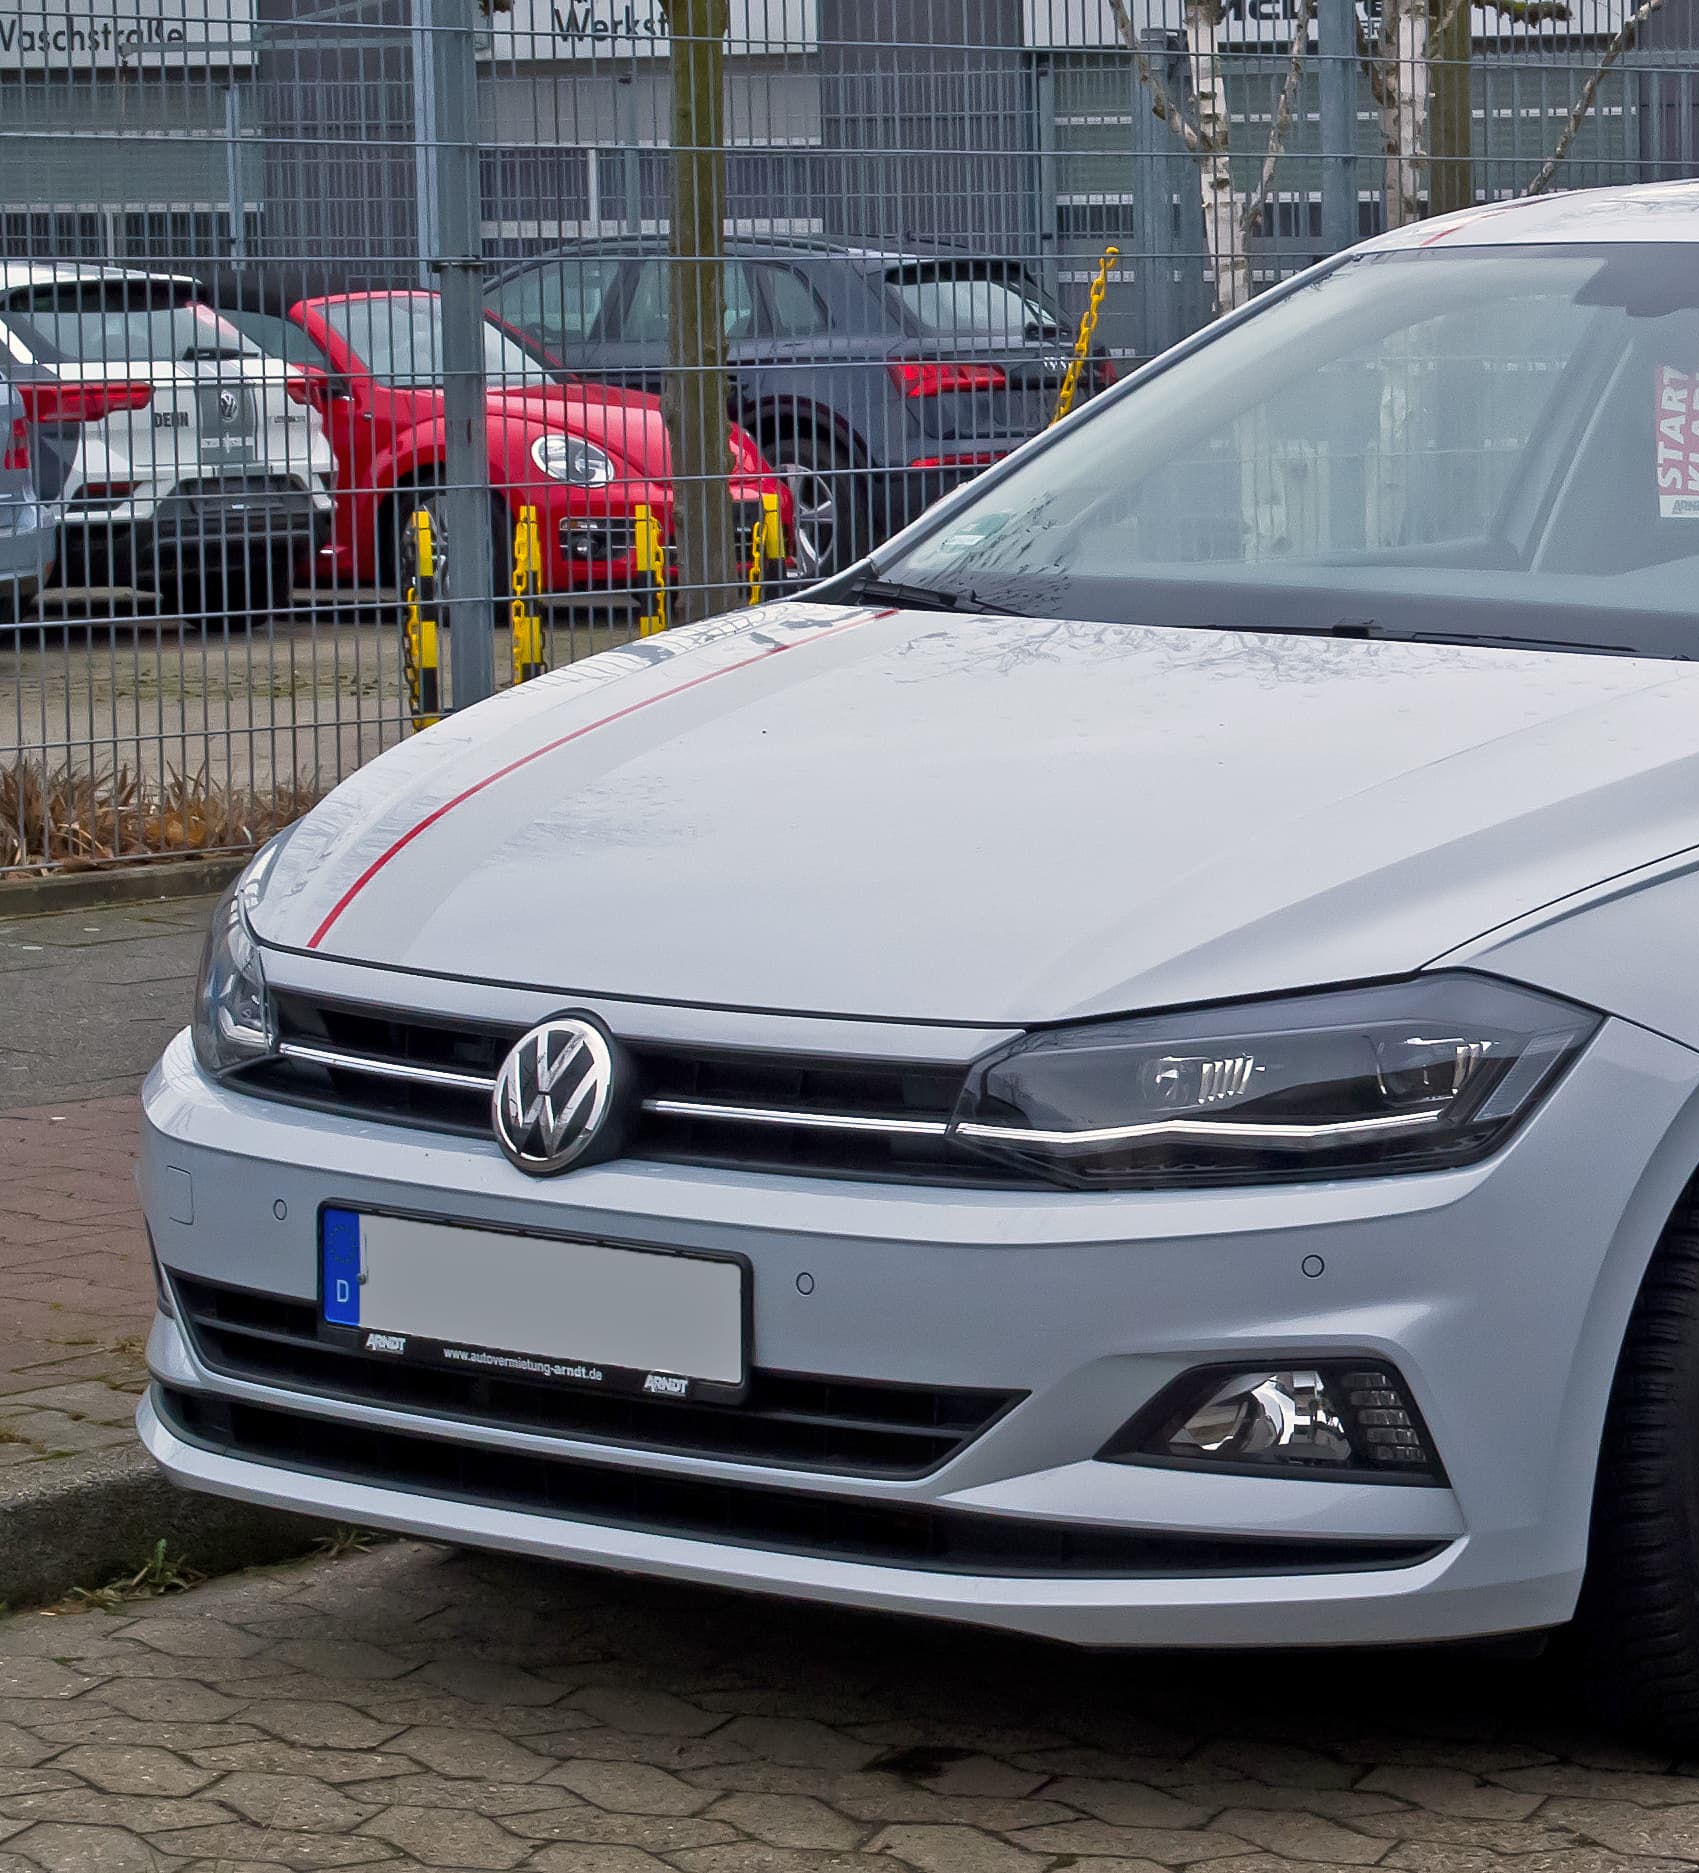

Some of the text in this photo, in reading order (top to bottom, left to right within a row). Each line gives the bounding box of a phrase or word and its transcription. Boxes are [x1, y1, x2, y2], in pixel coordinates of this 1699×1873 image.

[1657, 365, 1689, 489] START
[337, 1279, 350, 1303] D
[365, 1333, 689, 1396] ARNDT www.autovermietung-arndt.de ARNDT
